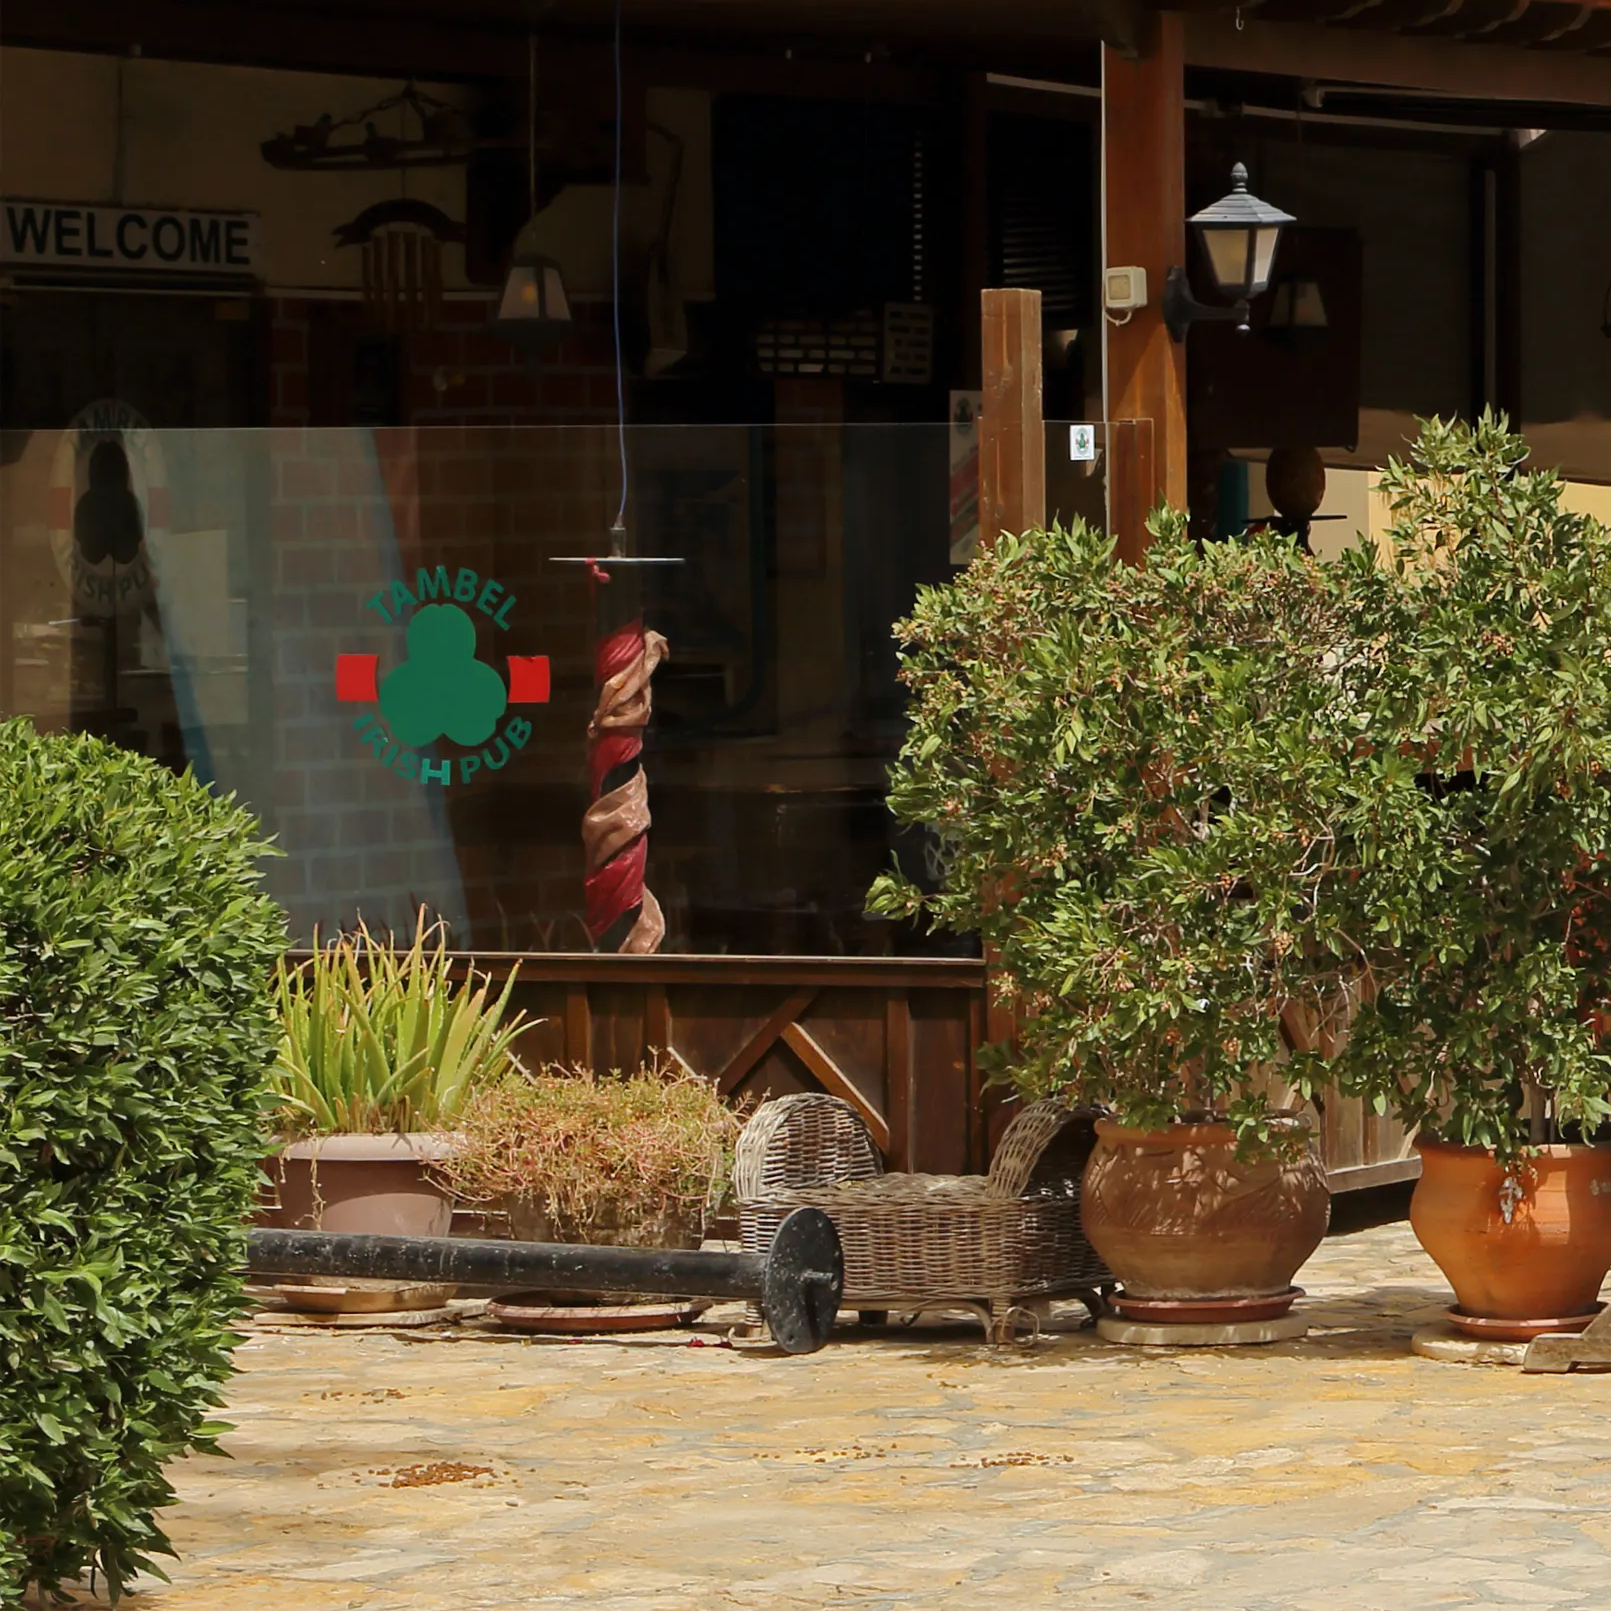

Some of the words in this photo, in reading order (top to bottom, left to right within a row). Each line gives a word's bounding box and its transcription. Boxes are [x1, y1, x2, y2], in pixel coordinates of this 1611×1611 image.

[6, 206, 250, 265] WELCOME
[365, 564, 517, 632] TAMBEL
[352, 712, 451, 786] IRISH
[459, 716, 533, 785] PUB
